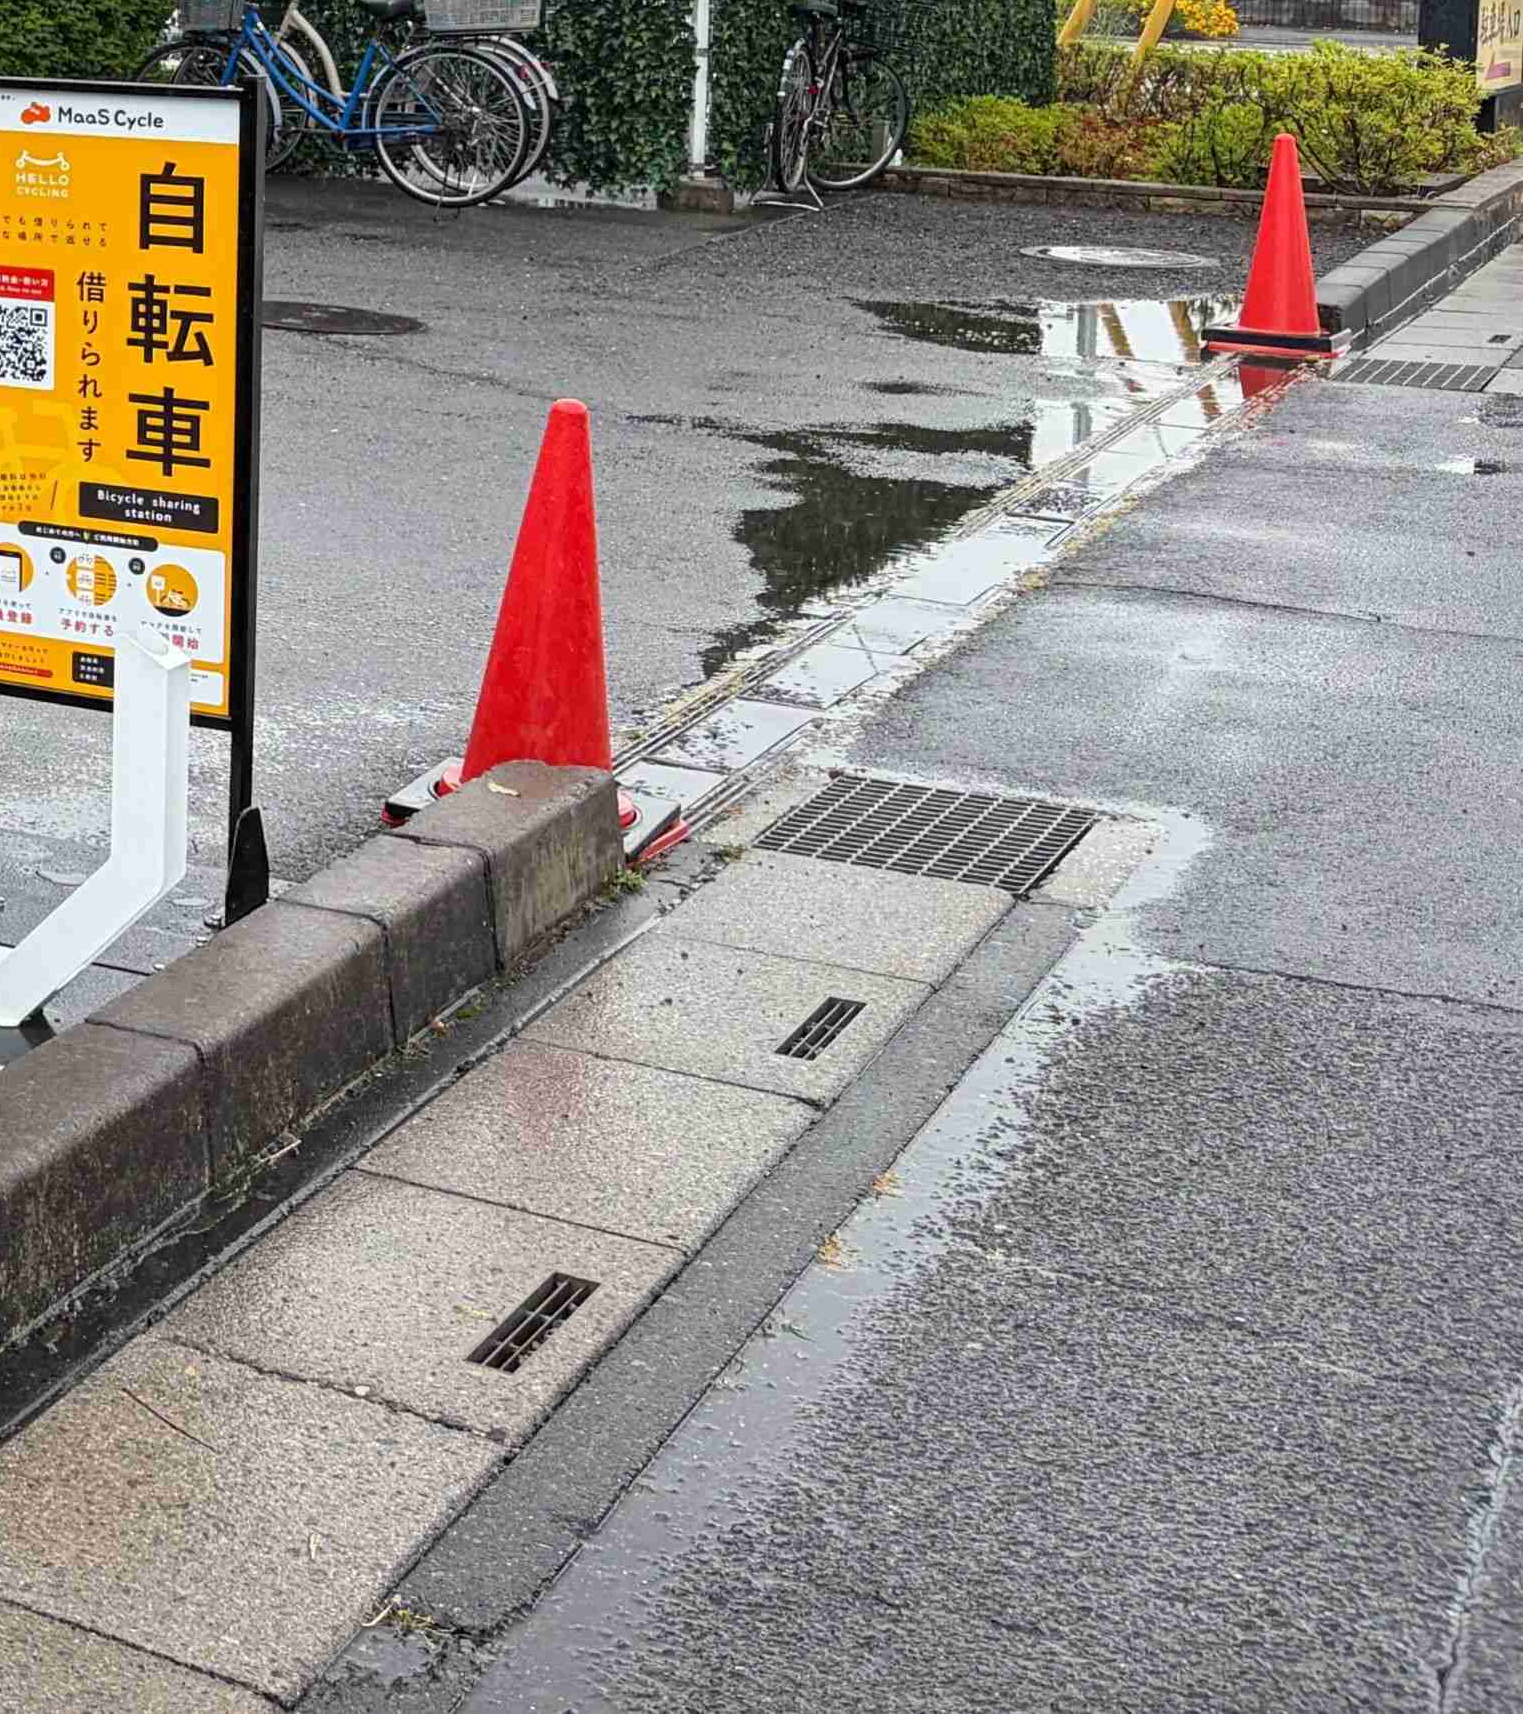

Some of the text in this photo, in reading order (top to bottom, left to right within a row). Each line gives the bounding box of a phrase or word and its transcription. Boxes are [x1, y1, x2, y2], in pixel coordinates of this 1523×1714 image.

[57, 106, 164, 131] MaaS Cycle
[15, 172, 70, 186] HELLO
[16, 186, 70, 199] CYCLING
[126, 161, 214, 477] 自転車
[76, 271, 107, 462] 借りられます
[96, 489, 202, 515] Bicycle sharing
[124, 507, 173, 524] station
[60, 618, 114, 637] 予約する
